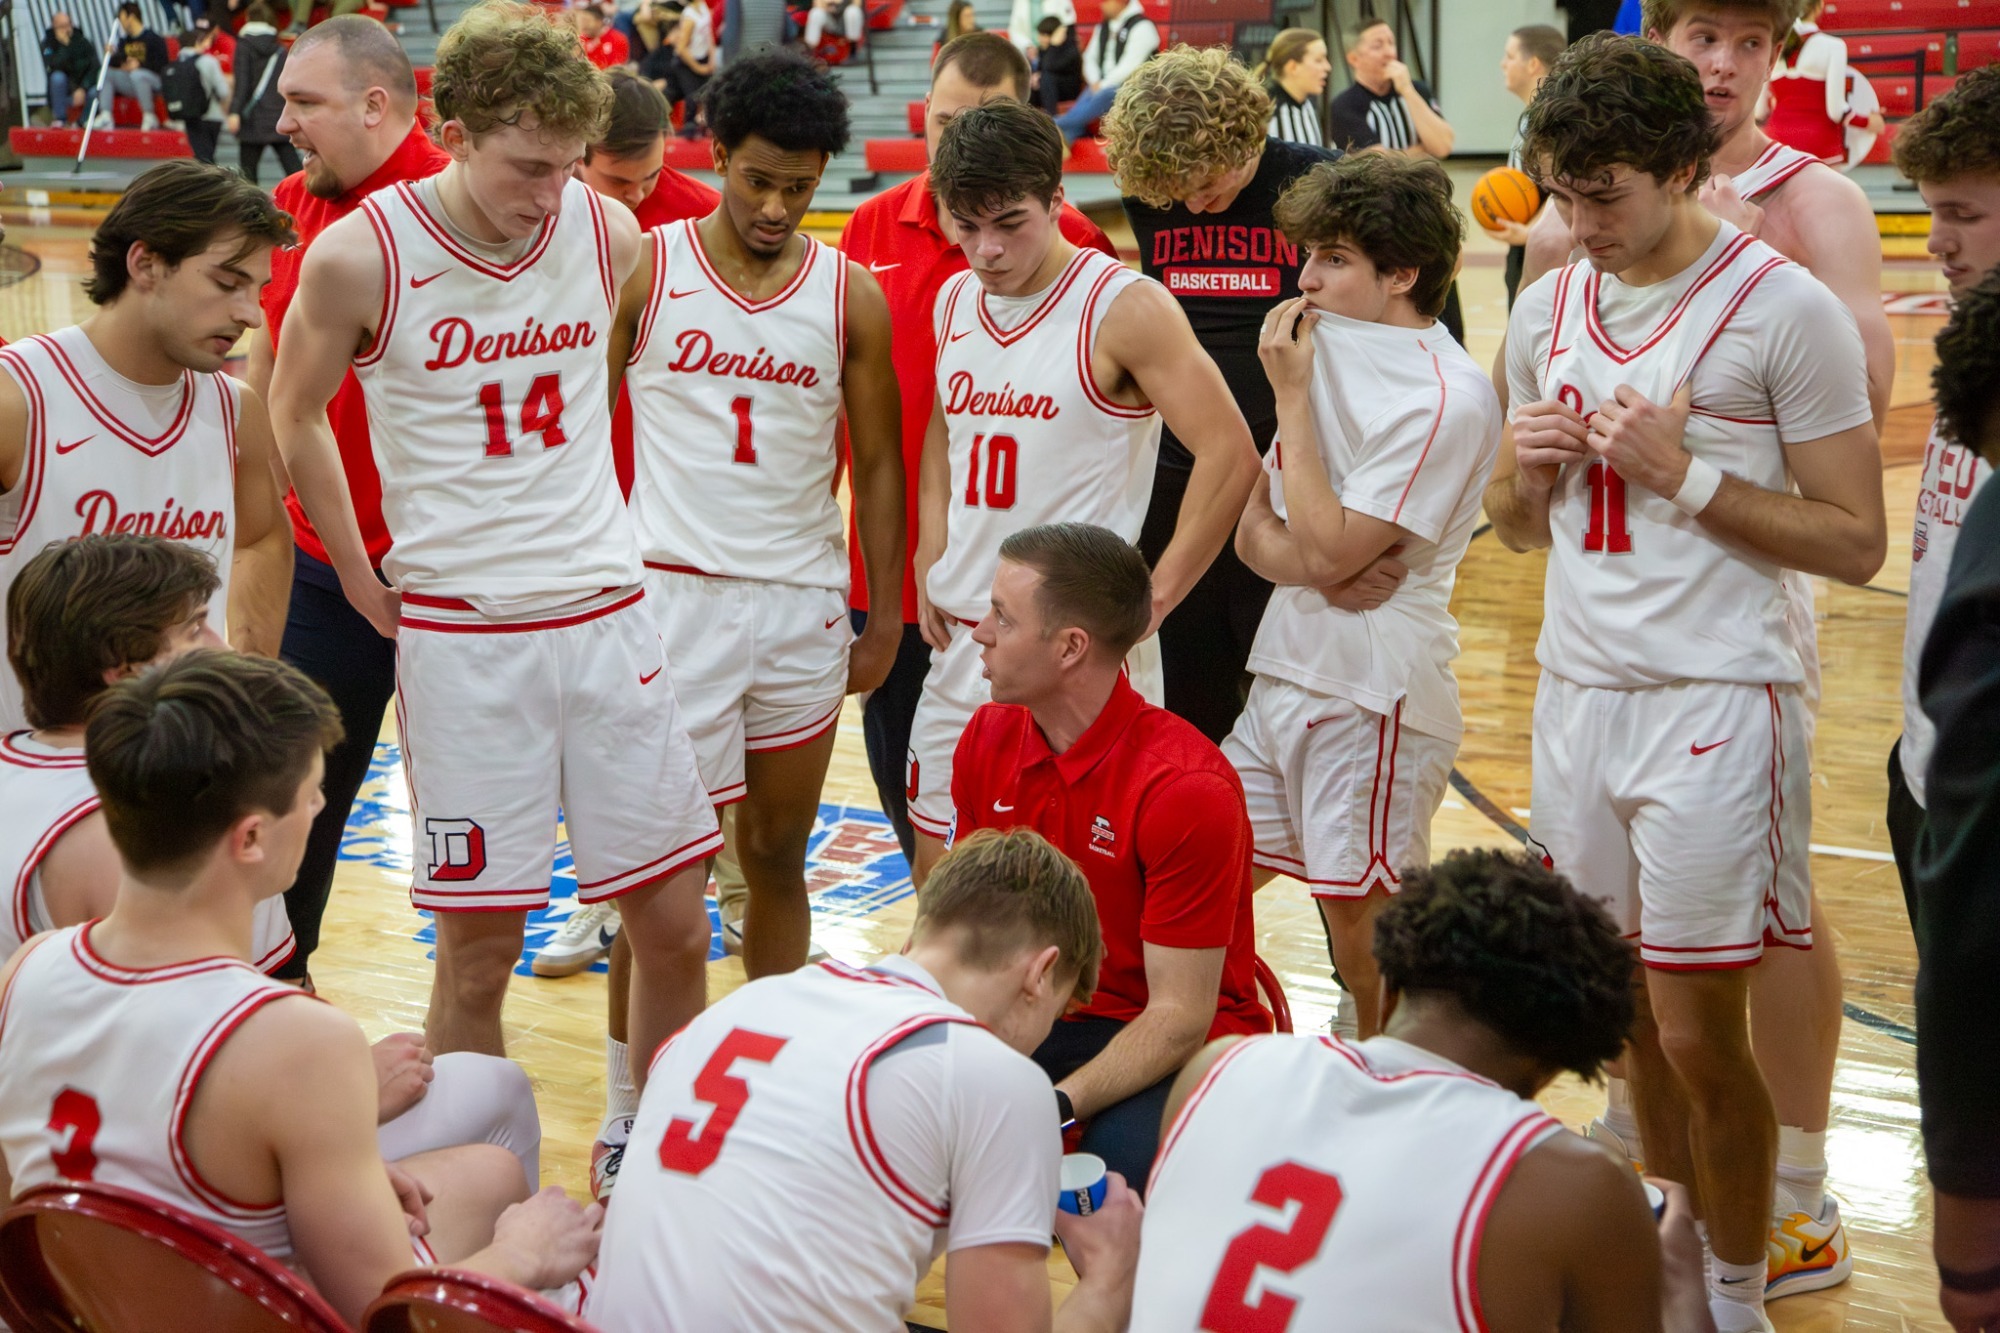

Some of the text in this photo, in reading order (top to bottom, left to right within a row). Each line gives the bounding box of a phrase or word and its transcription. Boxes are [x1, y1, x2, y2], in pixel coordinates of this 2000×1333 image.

[1152, 225, 1298, 268] DENISON
[1170, 273, 1272, 291] BASKETBALL
[424, 316, 597, 371] Denison
[668, 329, 820, 388] Denison
[476, 370, 571, 460] 14
[945, 370, 1060, 420] Denison
[728, 393, 759, 467] 1
[964, 431, 1020, 512] 10
[67, 489, 227, 544] Denison
[1581, 459, 1636, 556] 11
[426, 817, 487, 881] D
[656, 1025, 793, 1179] 5
[1194, 1157, 1349, 1333] 2
